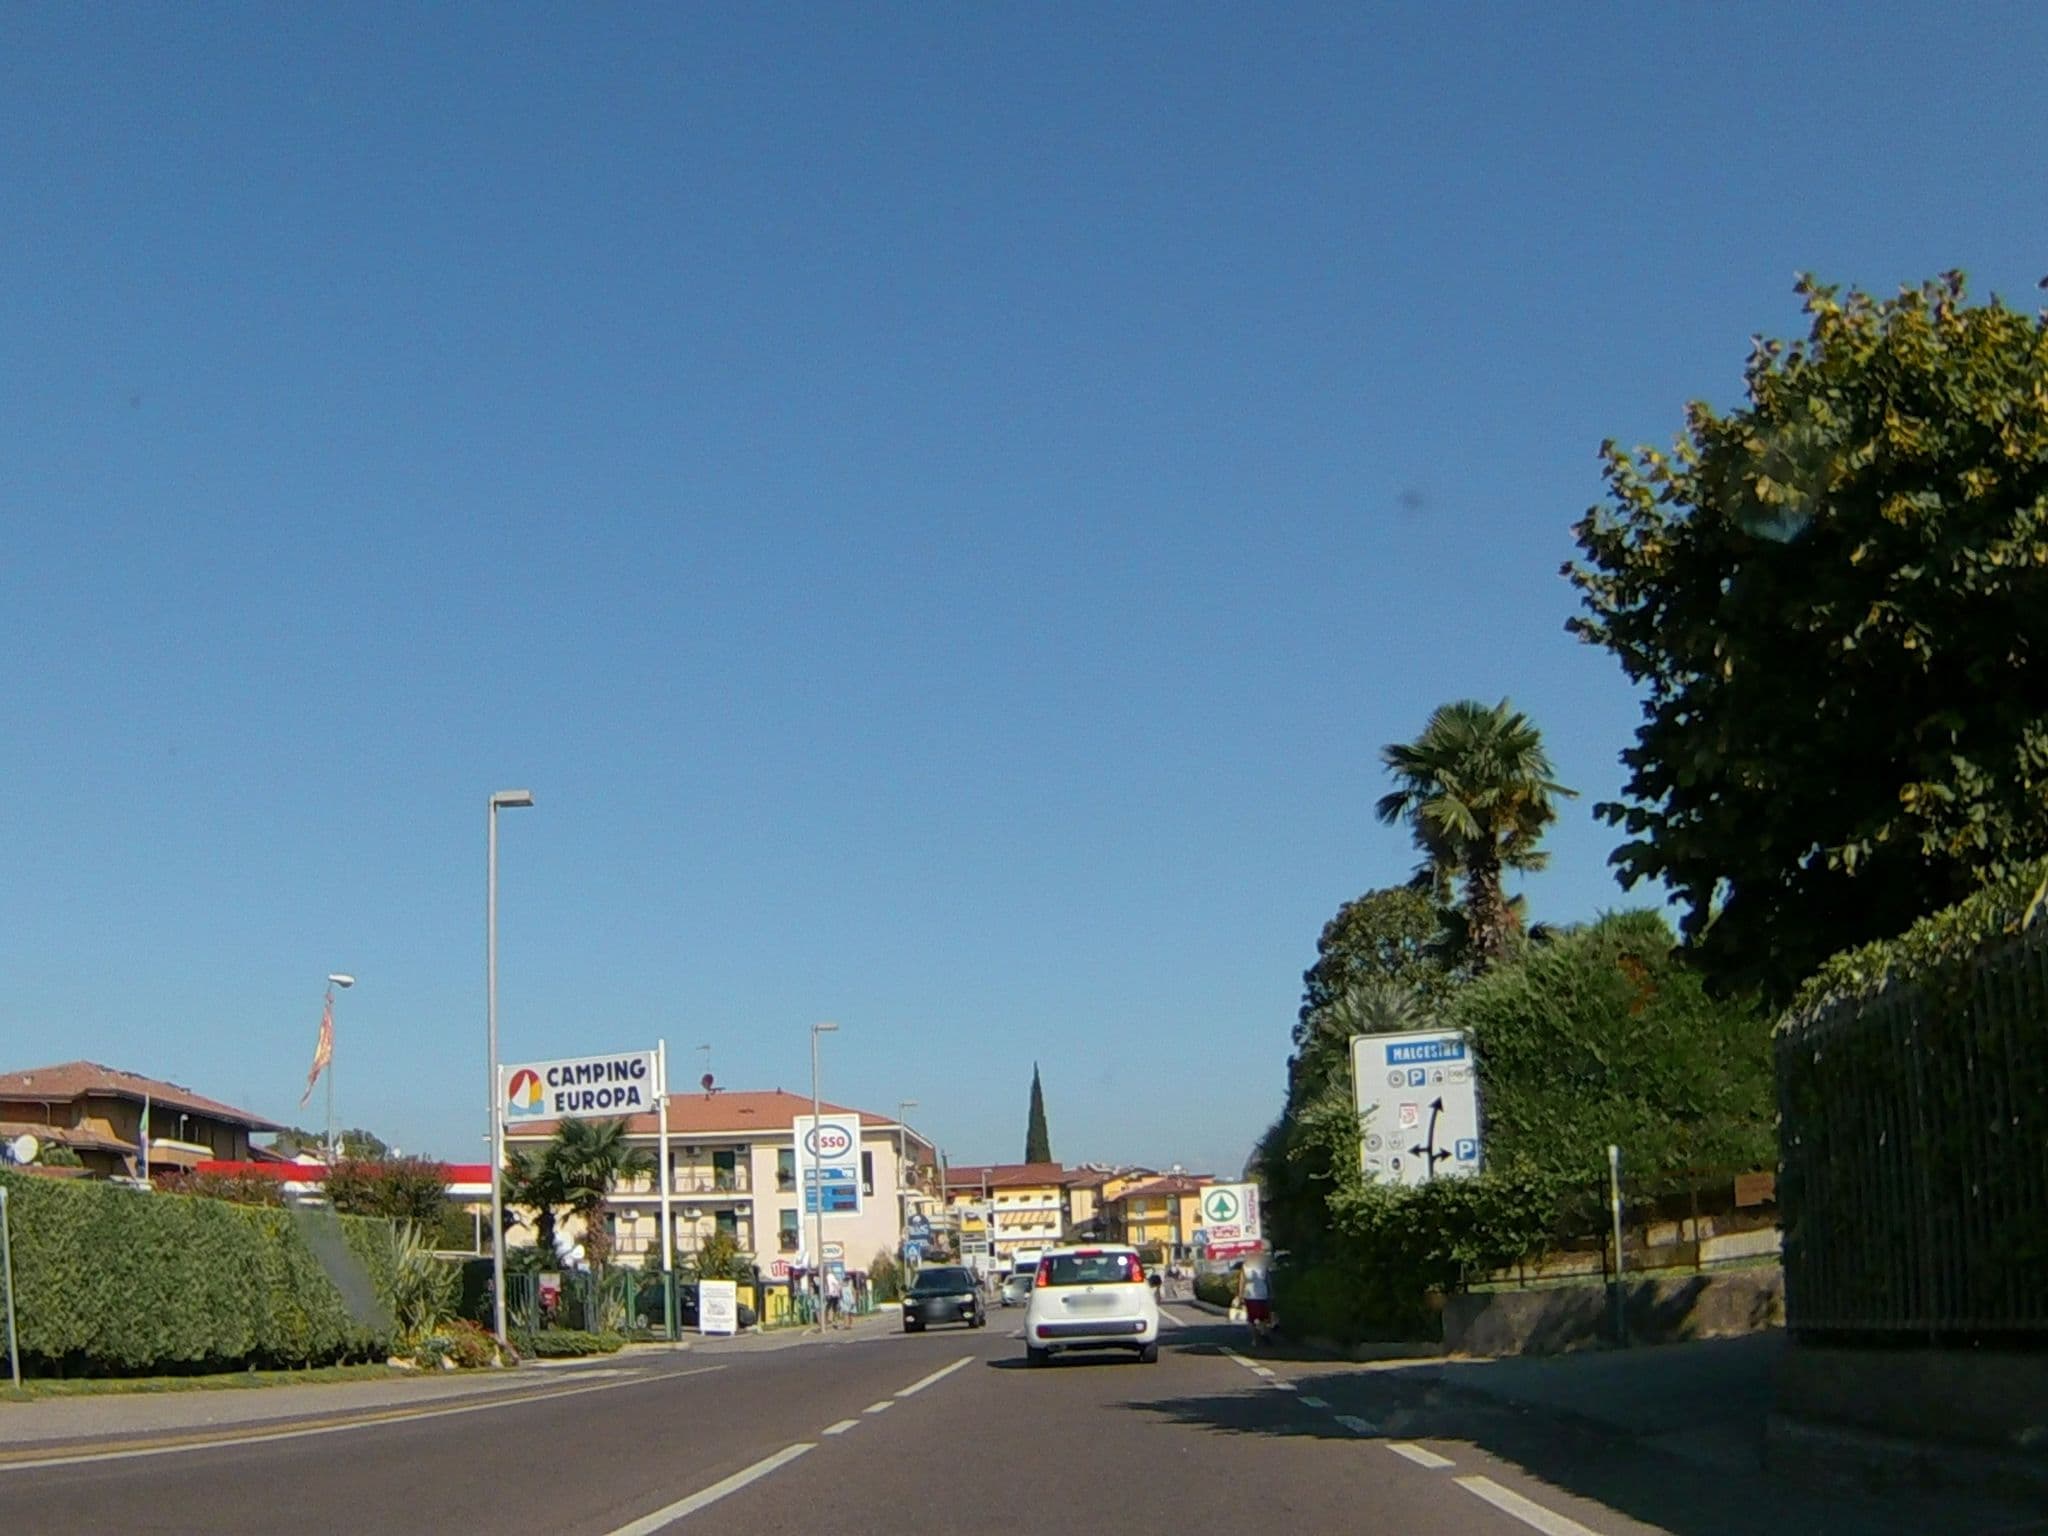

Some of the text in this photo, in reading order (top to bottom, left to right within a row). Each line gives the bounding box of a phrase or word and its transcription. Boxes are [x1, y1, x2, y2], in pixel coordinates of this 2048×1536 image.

[546, 1058, 646, 1087] CAMPING
[554, 1085, 641, 1112] EUROPA
[1459, 1141, 1473, 1159] P
